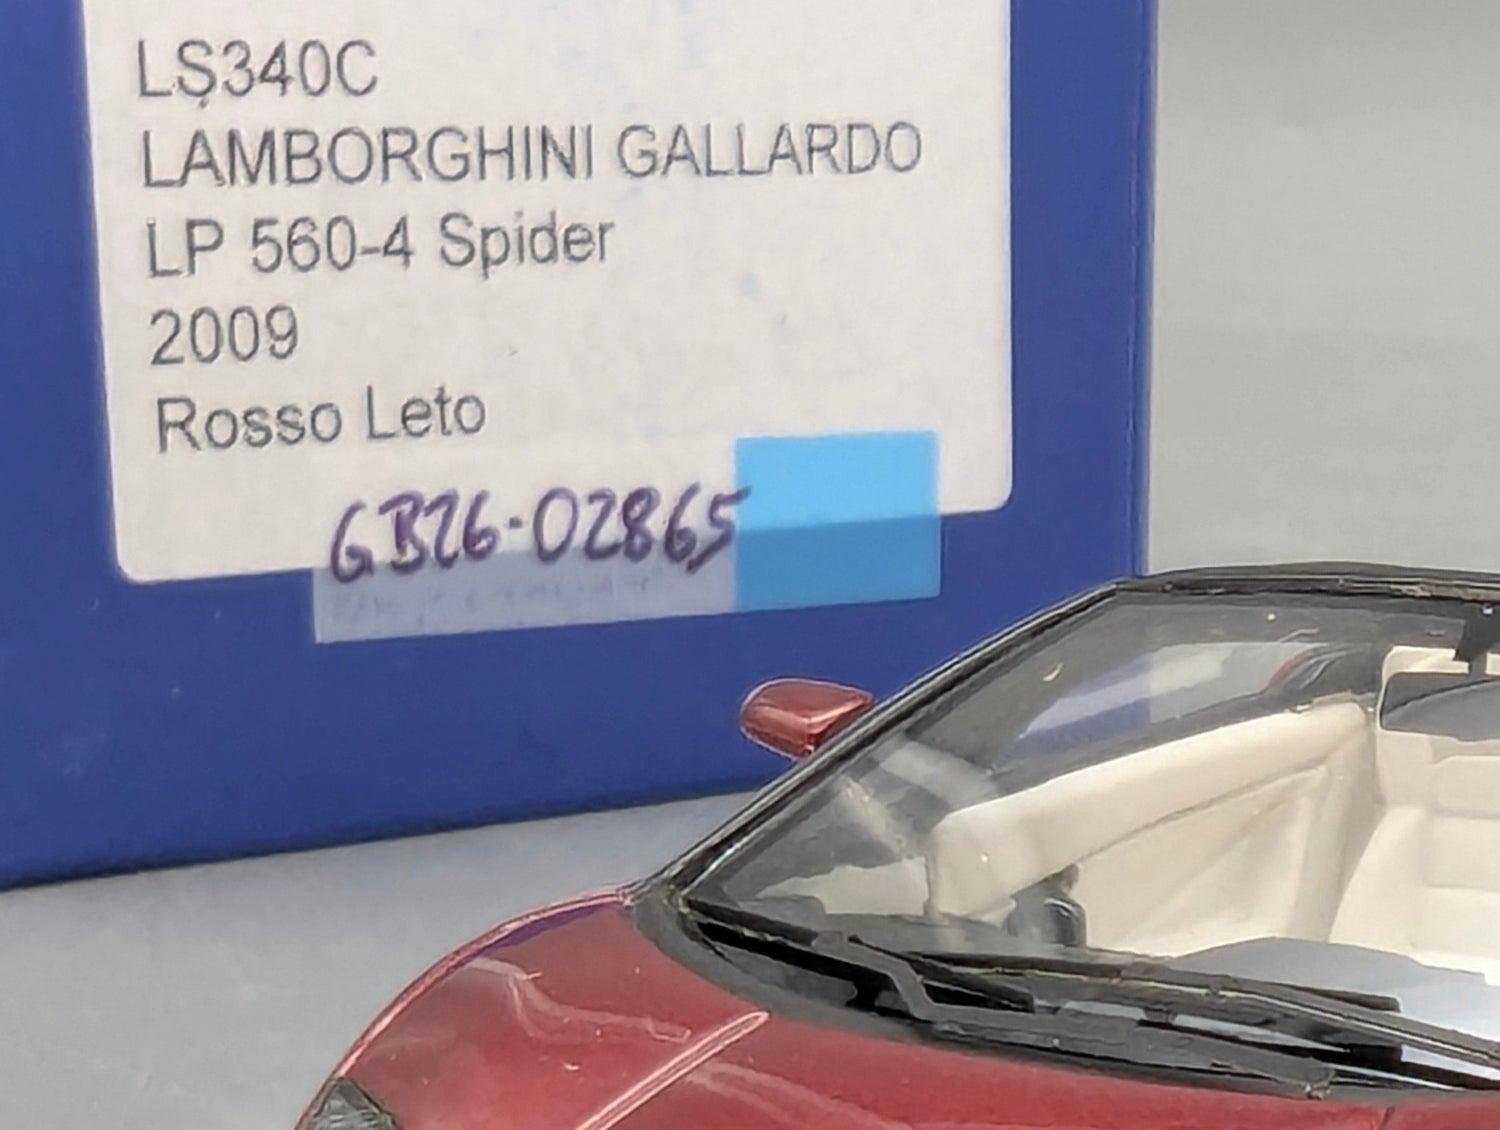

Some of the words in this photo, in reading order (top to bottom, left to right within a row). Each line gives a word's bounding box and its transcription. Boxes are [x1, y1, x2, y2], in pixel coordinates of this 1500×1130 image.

[137, 39, 379, 99] LS340C
[142, 124, 594, 188] LAMBORGHINI
[617, 121, 923, 179] GALLARDO
[146, 218, 225, 278] LP
[251, 215, 415, 274] 560-4
[439, 211, 614, 280] Spider
[150, 304, 299, 366] 2009
[156, 397, 343, 453] Rosso
[366, 385, 487, 440] Leto
